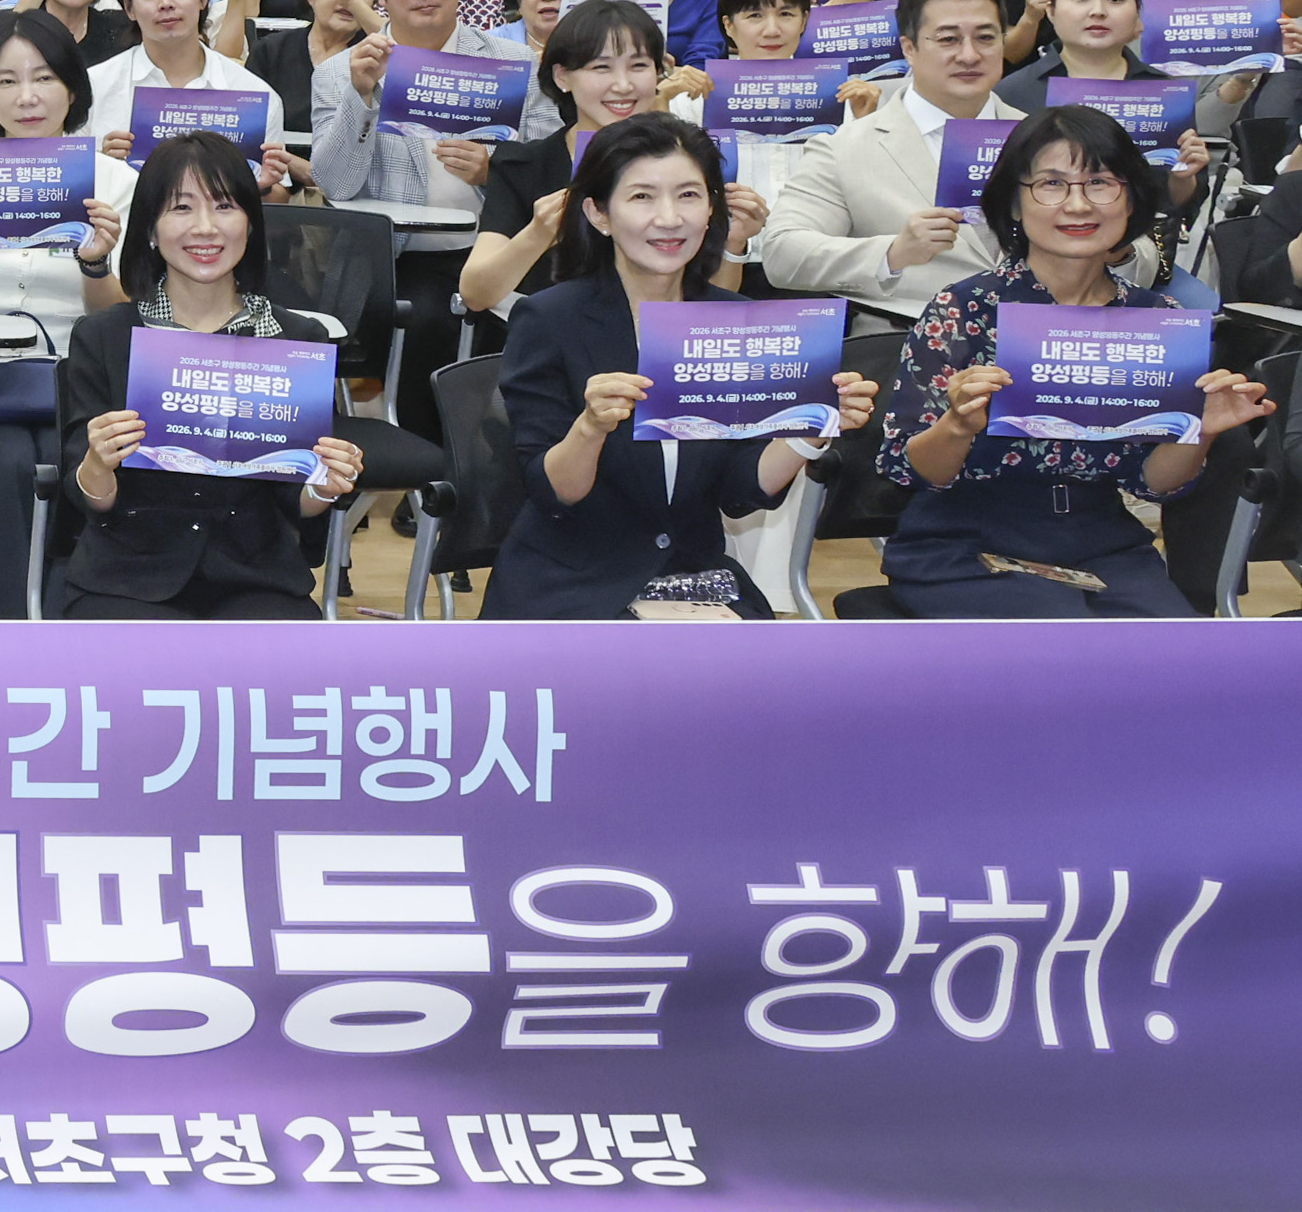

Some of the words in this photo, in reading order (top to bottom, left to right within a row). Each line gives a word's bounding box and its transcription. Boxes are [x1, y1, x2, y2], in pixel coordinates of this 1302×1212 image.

[1169, 14, 1209, 27] 내일도
[1212, 12, 1252, 25] 행복한
[1163, 27, 1228, 41] 양성평등을
[1231, 28, 1259, 39] 향해!
[734, 83, 774, 95] 내일도
[778, 82, 818, 95] 행복한
[727, 97, 791, 110] 양성평등을
[795, 98, 823, 109] 향해!
[310, 352, 326, 361] 서초
[683, 339, 741, 358] 내일도
[746, 336, 801, 357] 행복한
[1041, 341, 1101, 361] 내일도
[1106, 343, 1166, 364] 행복한
[180, 356, 200, 365] 2026
[172, 368, 230, 392] 내일도
[234, 373, 291, 397] 행복한
[673, 362, 765, 383] 양성평등을
[770, 362, 809, 380] 향해!
[1031, 364, 1127, 386] 양성평등을
[1132, 369, 1174, 388] 향해!
[161, 391, 254, 419] 양성평등을
[259, 402, 299, 422] 향해!
[166, 424, 192, 435] 2026.
[229, 430, 286, 443] 14:00~16:00
[144, 684, 566, 804] 기념행사
[744, 861, 1223, 1055] 향해!
[284, 1114, 434, 1187] 2층
[449, 1112, 707, 1187] 대강당
